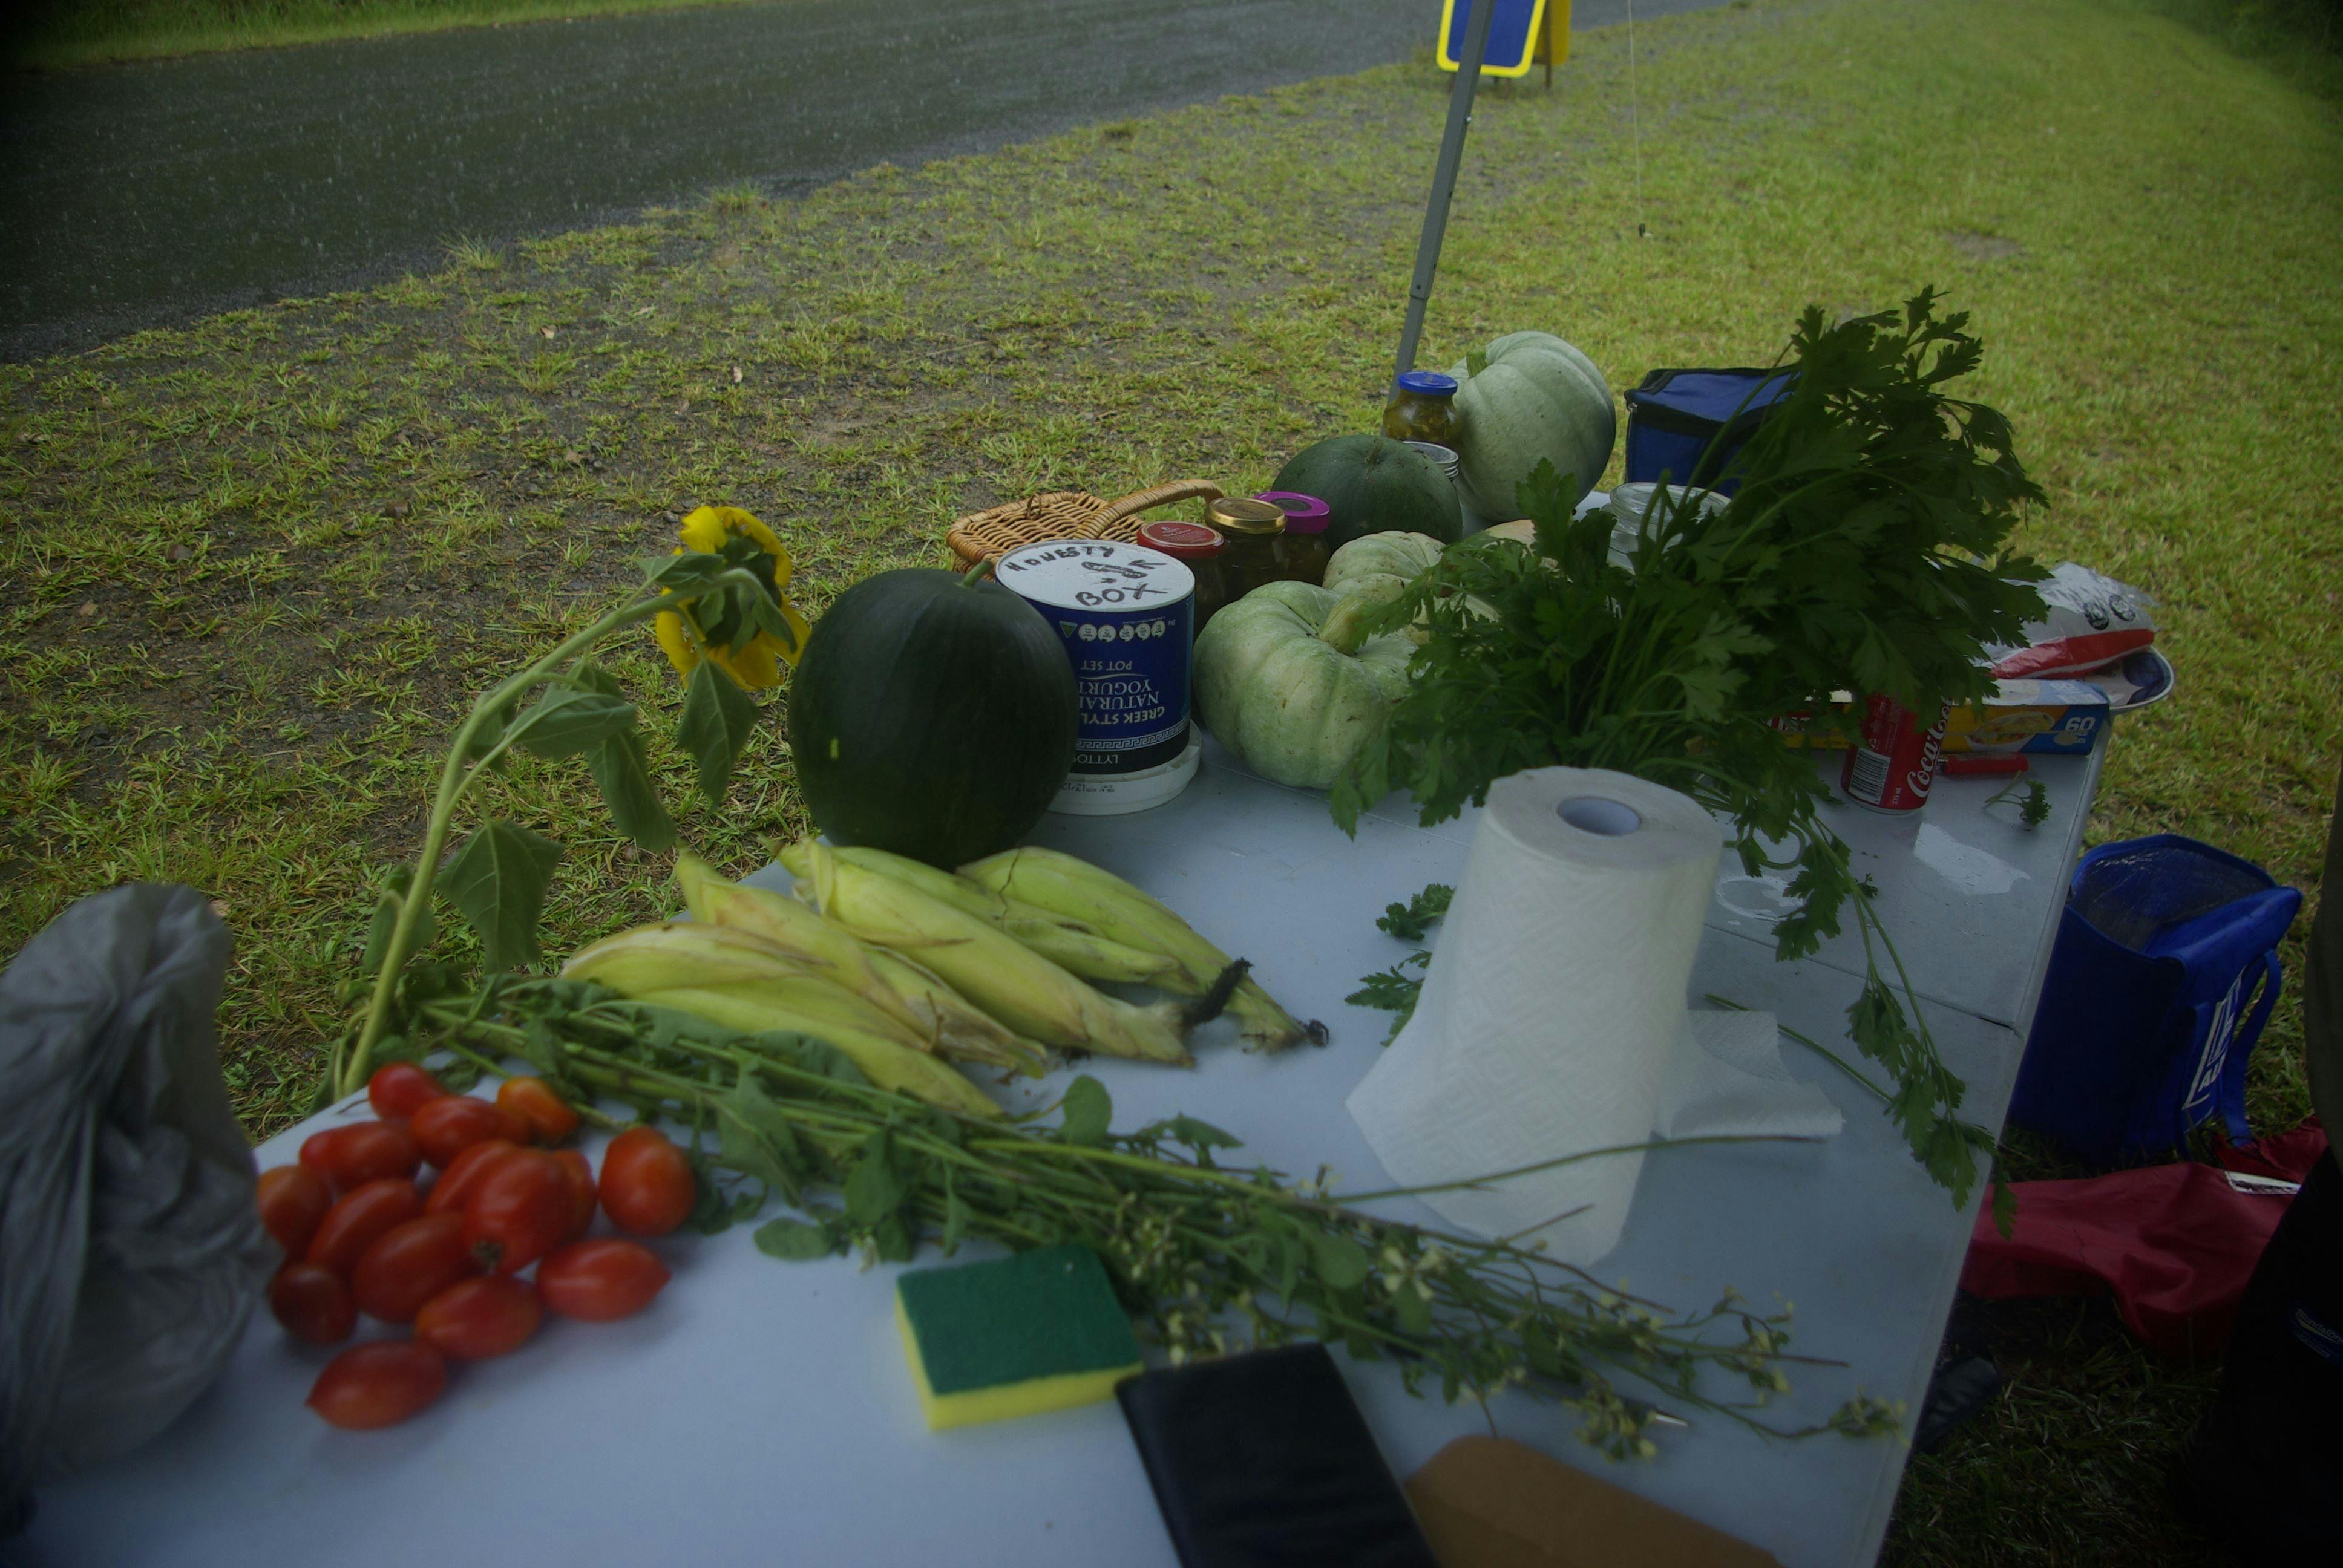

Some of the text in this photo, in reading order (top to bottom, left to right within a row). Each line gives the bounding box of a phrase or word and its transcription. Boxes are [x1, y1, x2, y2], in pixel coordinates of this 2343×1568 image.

[1005, 546, 1115, 572] HONESTY
[1075, 583, 1168, 606] BOX
[1081, 660, 1132, 671] POT SET
[1078, 679, 1152, 695] YOGURT
[1081, 706, 1165, 725] GREEK STYL
[2064, 716, 2096, 731] 60
[1075, 754, 1119, 765] LYTTO
[2295, 1307, 2343, 1342] Blundston
